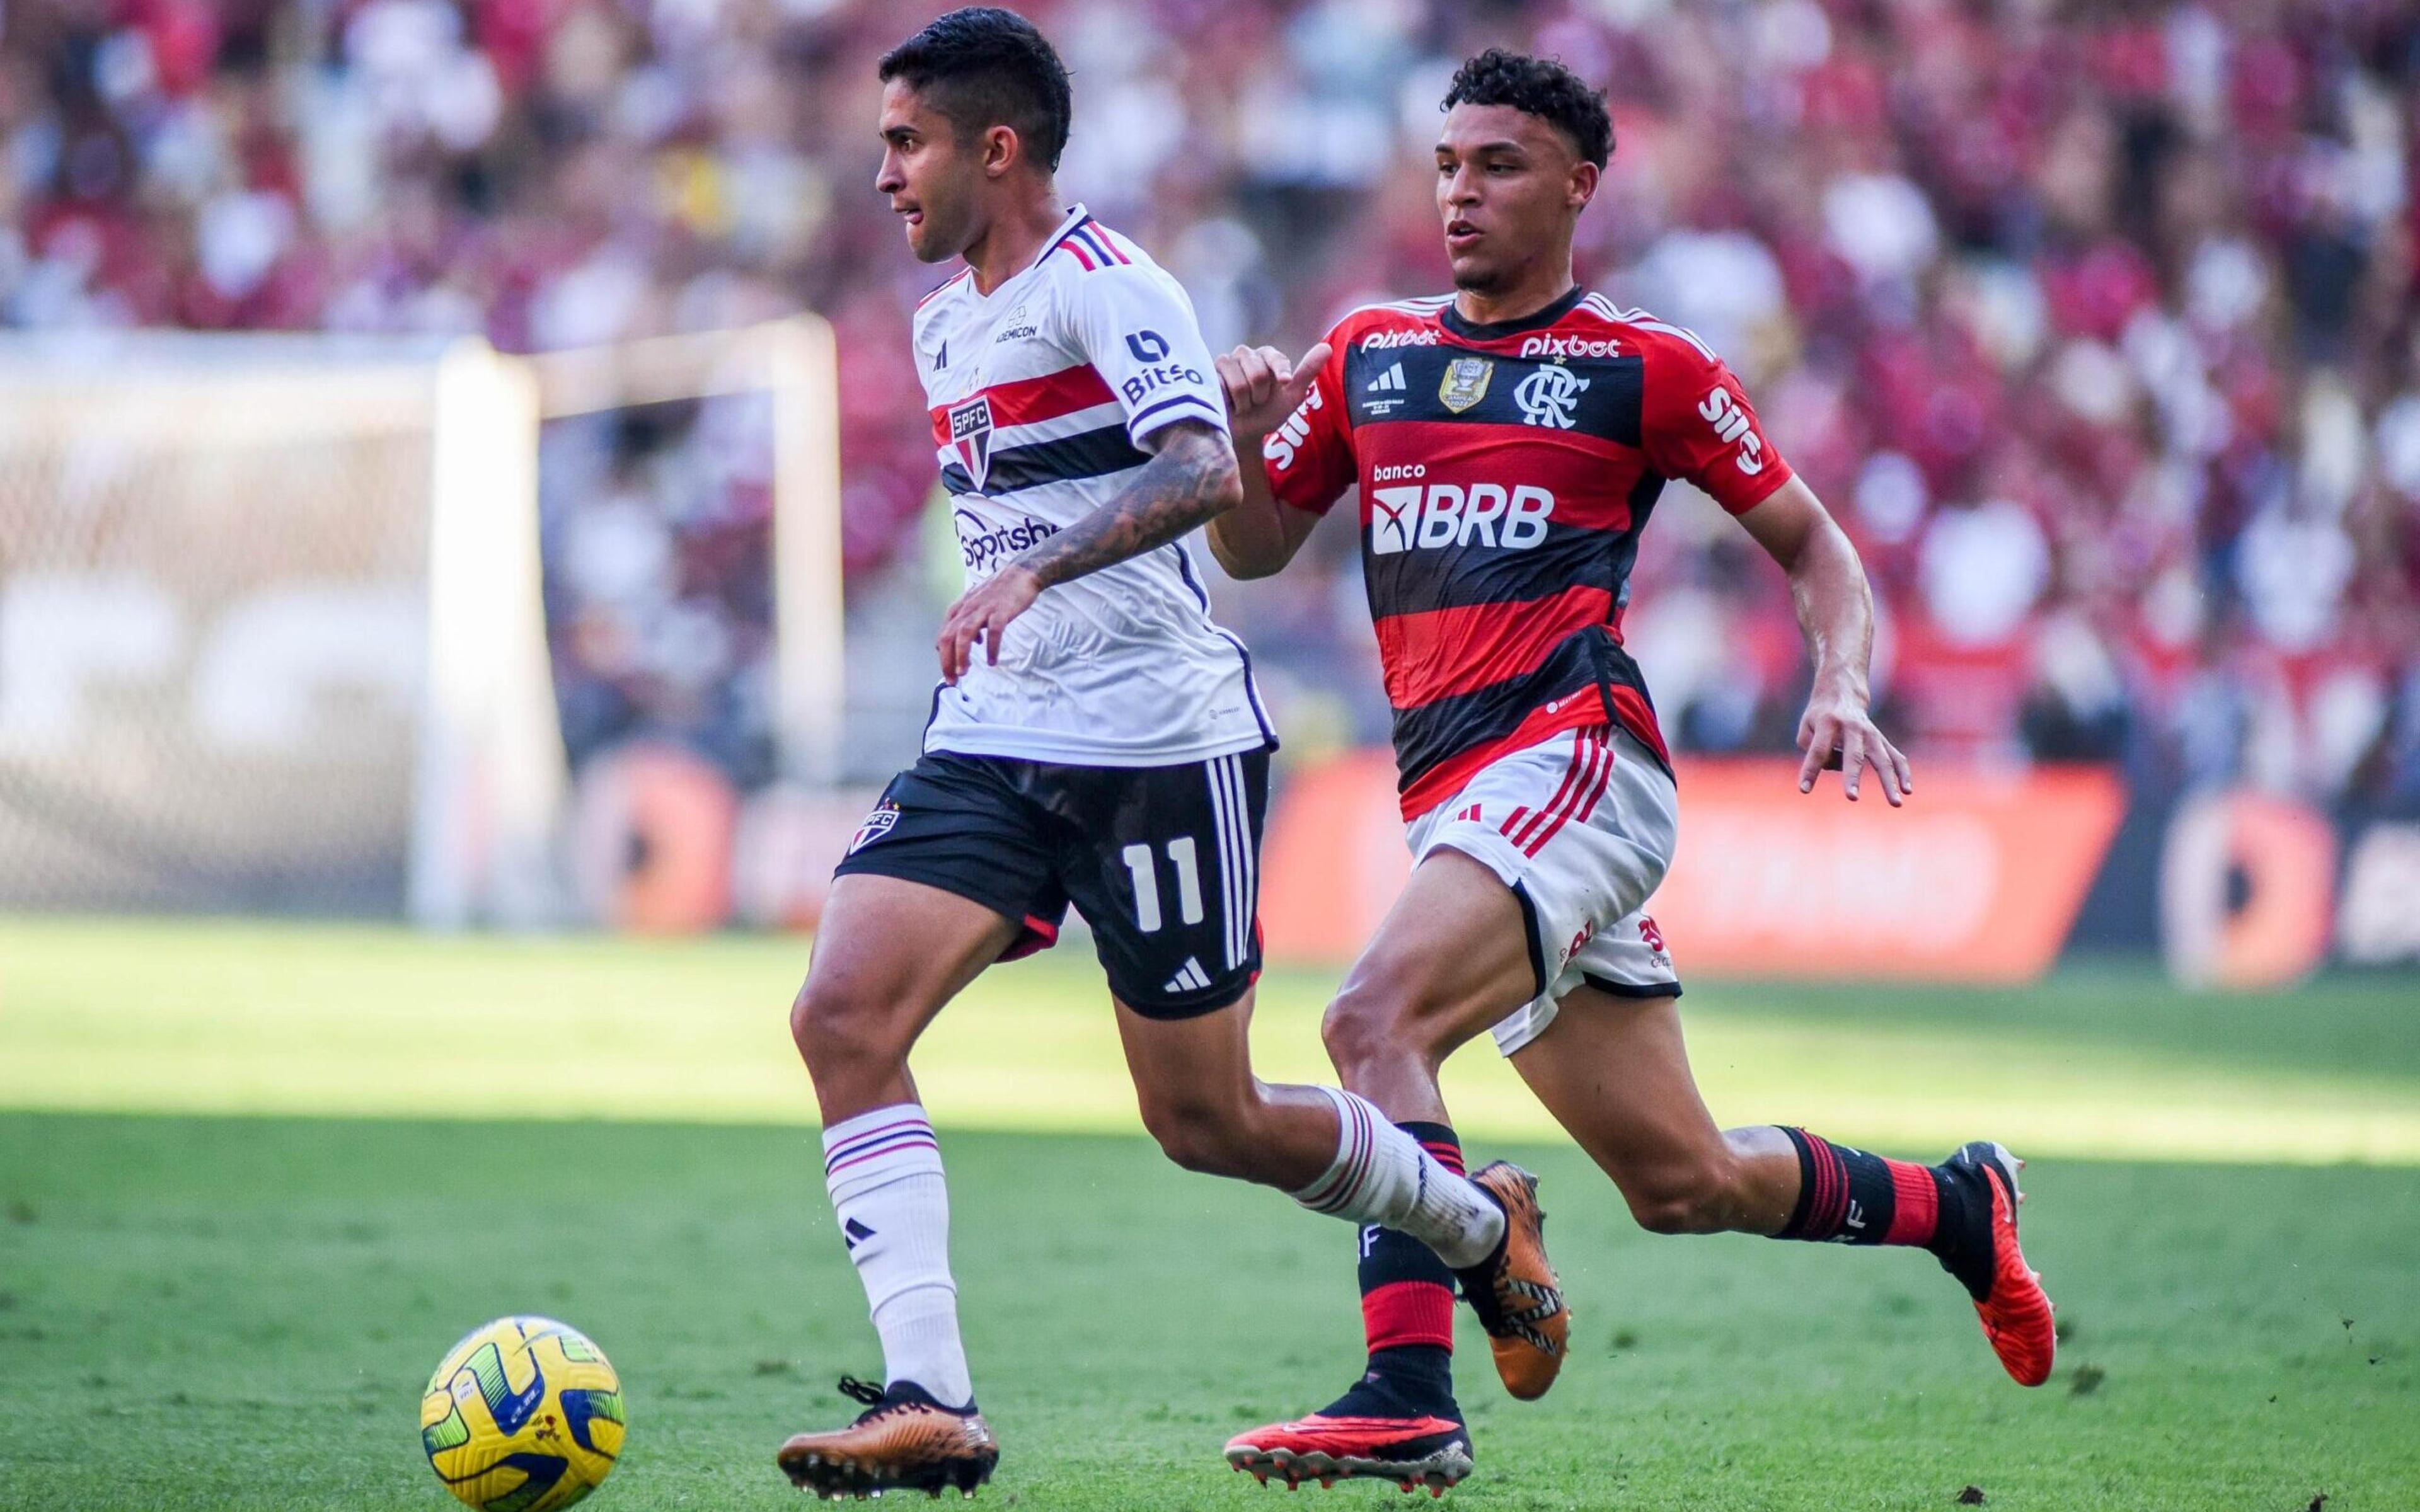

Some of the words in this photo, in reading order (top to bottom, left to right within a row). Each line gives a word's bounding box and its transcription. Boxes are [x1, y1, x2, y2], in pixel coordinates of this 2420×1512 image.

[1519, 332, 1622, 358] pixbet
[1122, 364, 1204, 407] Bitso
[954, 405, 987, 435] SPFC
[1374, 464, 1426, 482] banco
[1418, 483, 1555, 550] BRB
[960, 517, 1064, 571] Sportsb
[866, 813, 894, 825] PFC
[1123, 836, 1204, 932] 11
